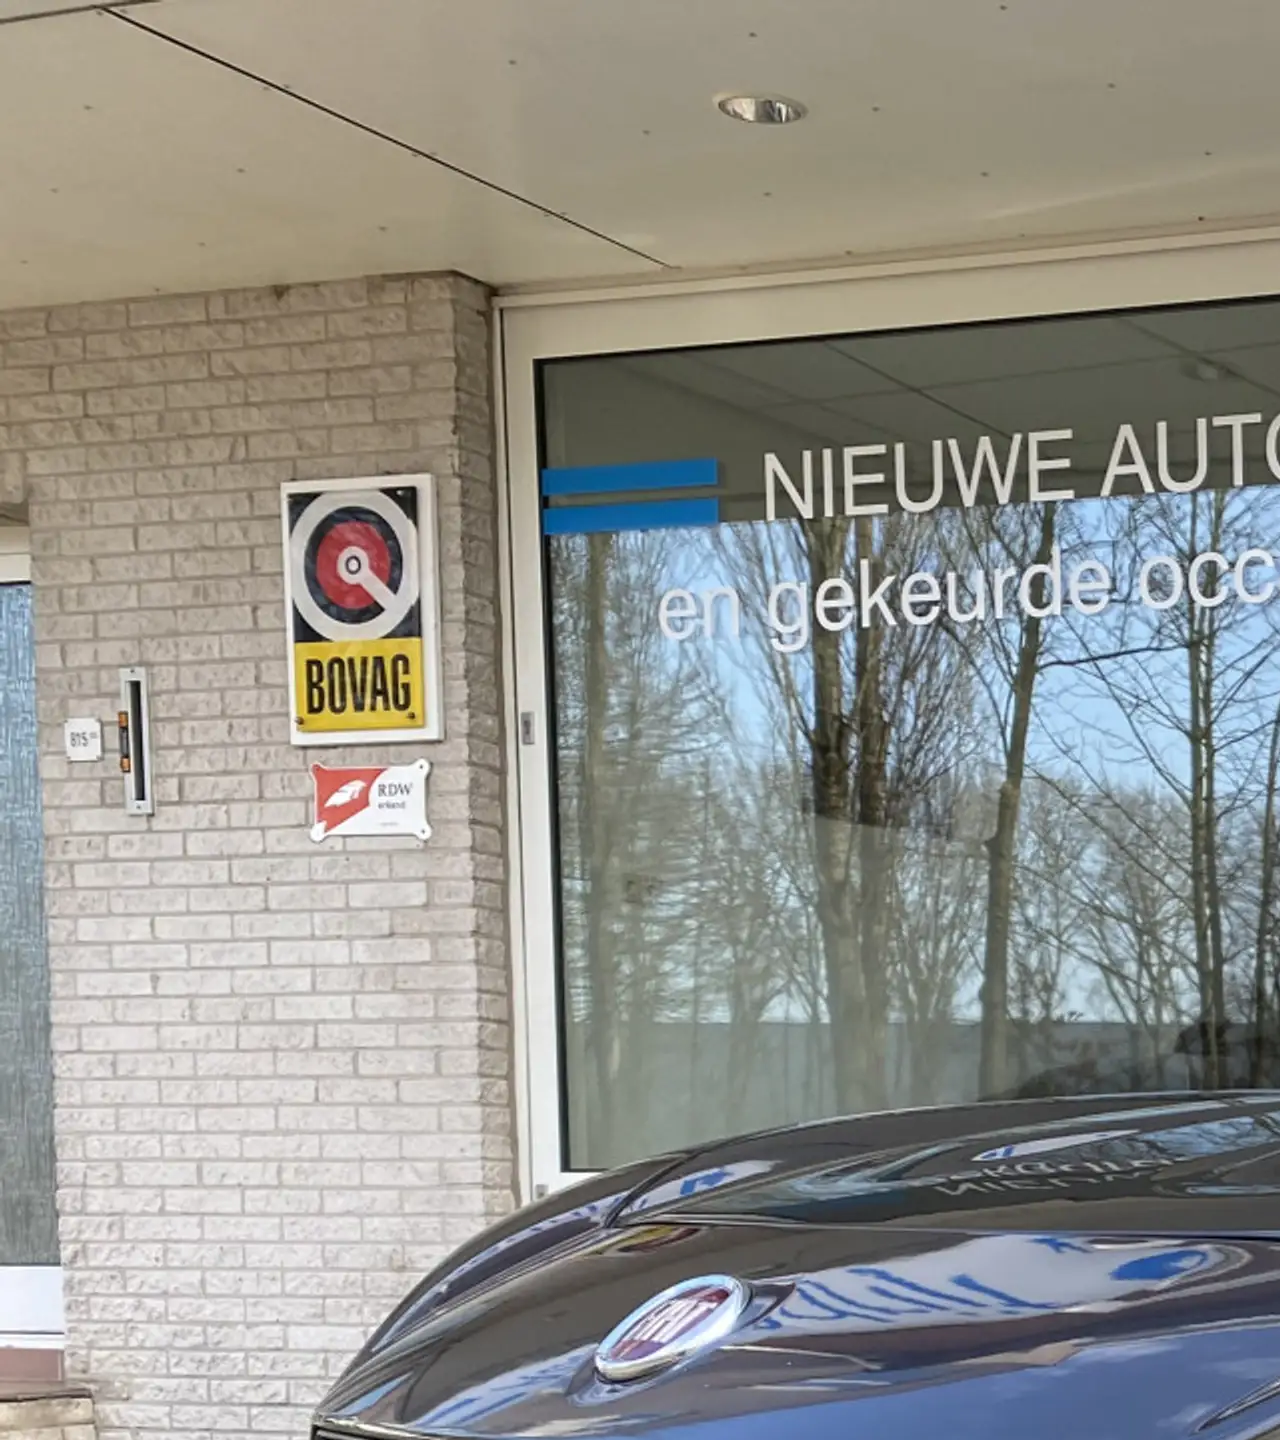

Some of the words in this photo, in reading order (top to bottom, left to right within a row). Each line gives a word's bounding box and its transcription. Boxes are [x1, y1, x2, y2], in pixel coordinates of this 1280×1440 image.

[764, 426, 1074, 521] NIEUWE
[657, 584, 741, 641] en
[768, 545, 1113, 653] gekeurde
[304, 653, 411, 716] BOVAG
[378, 783, 412, 797] RDW
